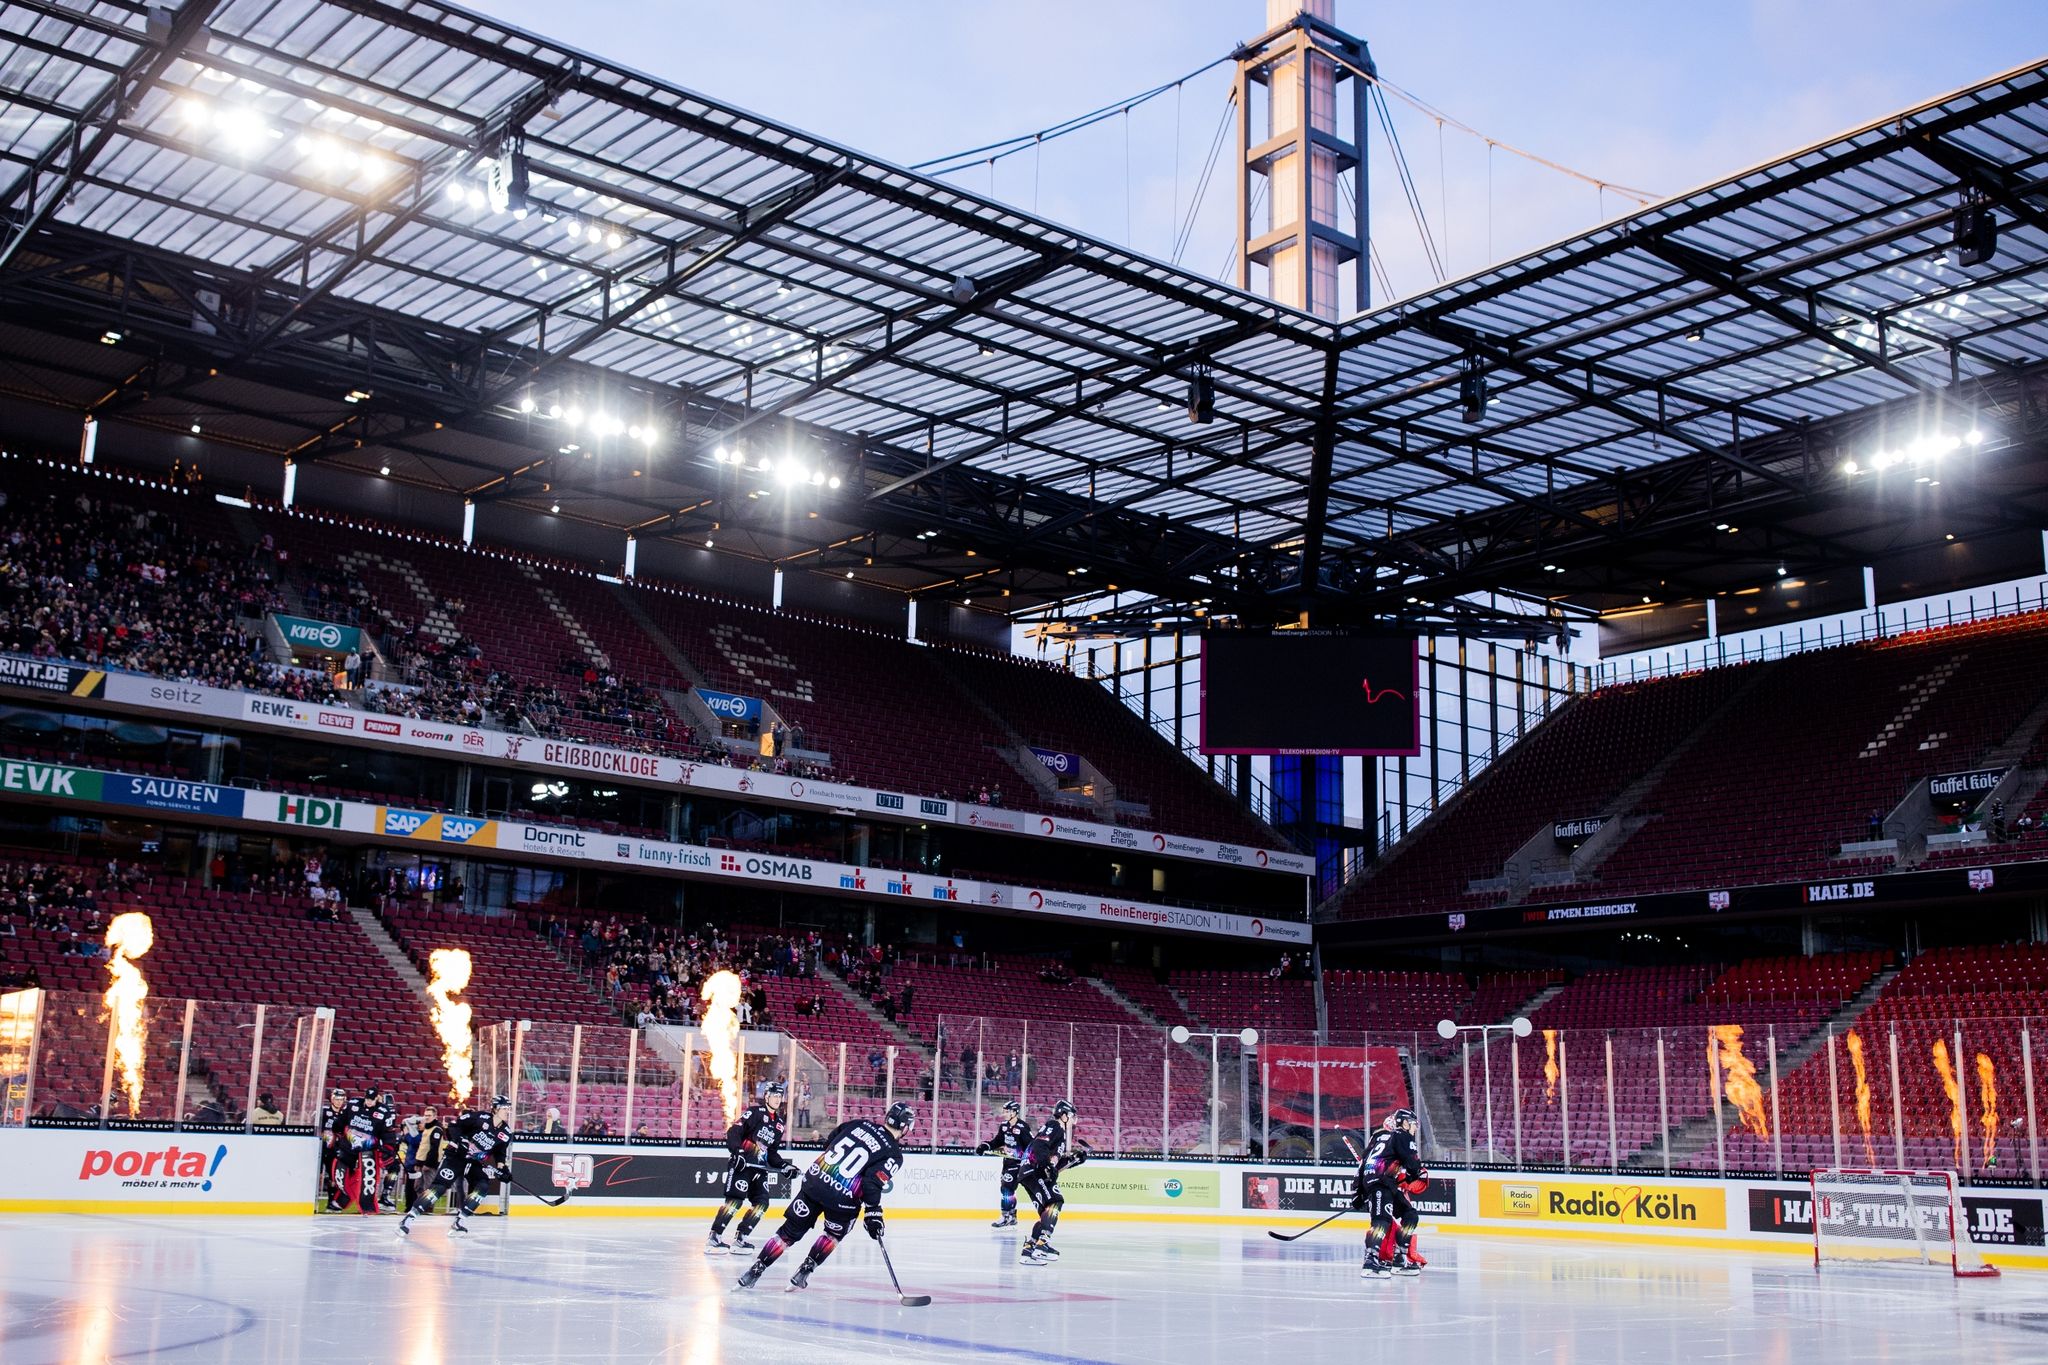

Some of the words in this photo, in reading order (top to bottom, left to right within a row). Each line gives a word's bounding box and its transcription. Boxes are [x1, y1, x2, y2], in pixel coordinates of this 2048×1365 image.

[290, 624, 320, 641] KVB
[150, 686, 202, 705] seitz
[251, 700, 294, 719] REWE
[708, 697, 730, 711] KVB
[320, 713, 353, 729] REWE
[411, 729, 443, 741] toom
[544, 743, 659, 778] GEIßBOCKLOGE
[0, 763, 76, 796] EVK
[1931, 775, 1968, 794] Gaffel
[131, 778, 219, 804] SAUREN
[878, 795, 902, 808] UTH
[922, 801, 946, 815] UTH
[278, 796, 343, 828] HDI
[385, 813, 421, 833] SAP
[442, 819, 476, 839] SAP
[1056, 824, 1097, 838] RheinEnergie
[1555, 822, 1583, 837] Gaffel
[524, 827, 585, 848] Dorint
[1111, 835, 1138, 848] Energie
[1113, 829, 1134, 839] Rhein
[523, 843, 547, 853] Hotels
[557, 846, 585, 857] Resorts
[639, 844, 711, 867] funny-frisch
[1167, 841, 1205, 855] RheinEnergie
[1220, 845, 1239, 855] Rhein
[1217, 851, 1243, 863] Energie
[1269, 856, 1304, 869] RheinEnergie
[746, 858, 812, 881] OSMAB
[1809, 881, 1875, 902] HAIE.DE
[1045, 898, 1087, 911] RheinEnergie
[1548, 903, 1638, 920] ATMEN.EISHOCKEY.
[1100, 903, 1211, 928] RheinEnergieSTADION
[1265, 924, 1300, 938] RheinEnergie
[551, 1153, 595, 1178] 50
[824, 1136, 869, 1179] 50
[79, 1144, 227, 1191] porta!
[884, 1157, 899, 1177] 50
[904, 1168, 963, 1180] MEDIAPARK
[964, 1170, 998, 1181] KLINIK
[122, 1179, 159, 1188] möbel
[160, 1180, 168, 1188] &
[169, 1179, 200, 1189] mehr
[820, 1171, 854, 1199] TOYOTA
[1086, 1182, 1110, 1191] BANDE
[1111, 1183, 1128, 1191] ZUM
[1163, 1182, 1179, 1190] VRS
[1284, 1178, 1315, 1193] DIE
[1510, 1190, 1533, 1199] Radio
[1513, 1200, 1531, 1209] Köln
[1549, 1190, 1621, 1217] Radio
[1636, 1193, 1697, 1221] Köln
